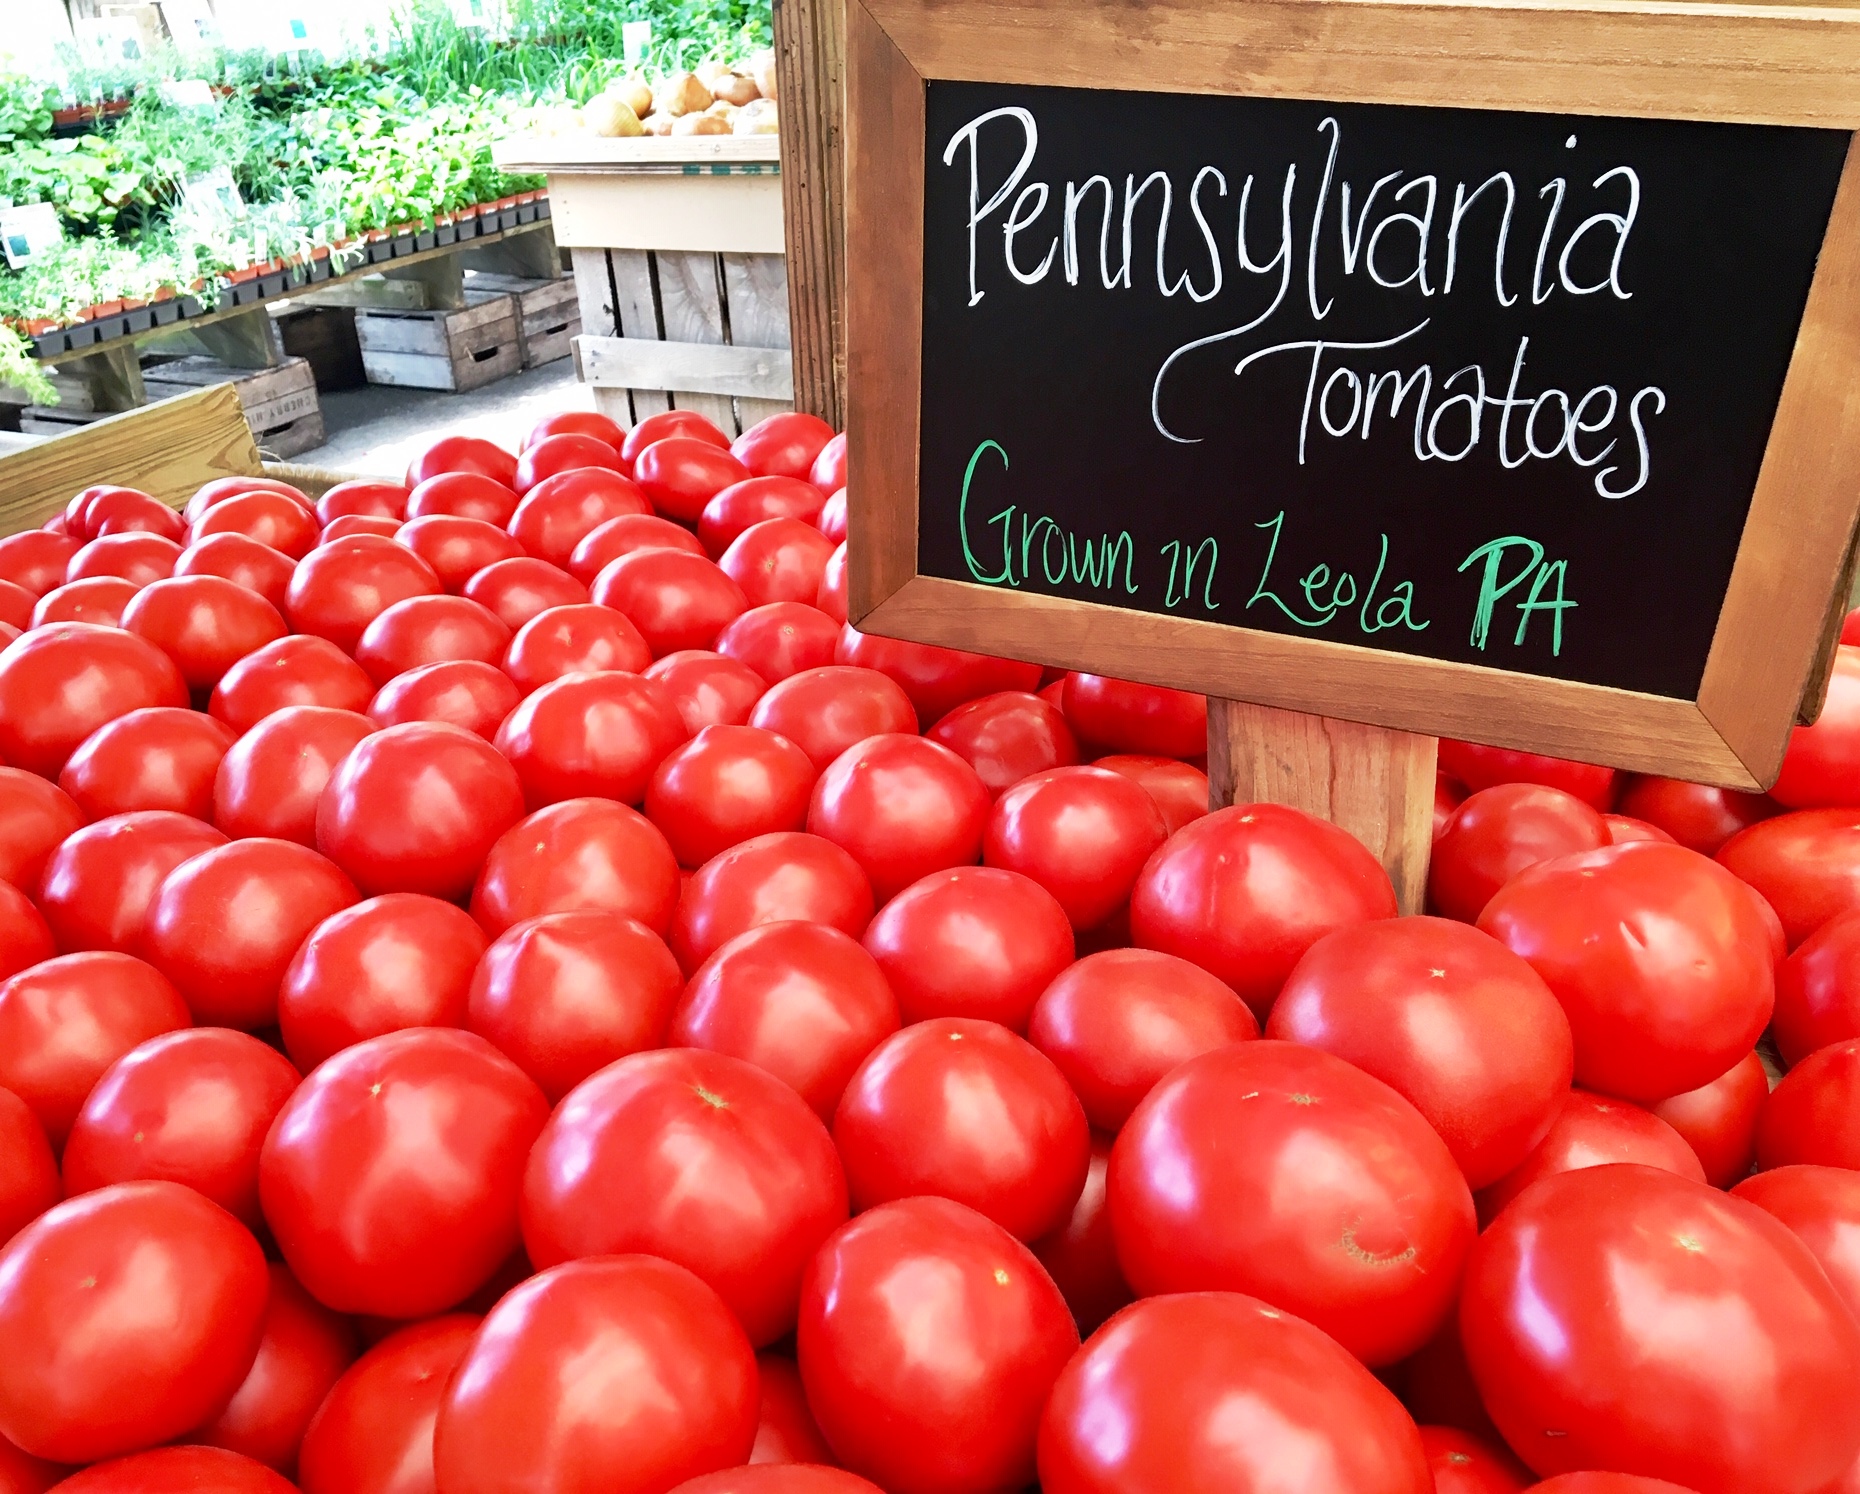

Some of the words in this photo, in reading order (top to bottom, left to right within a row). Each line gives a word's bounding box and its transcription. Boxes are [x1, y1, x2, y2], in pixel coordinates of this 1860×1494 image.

[943, 106, 1640, 444] Pennsylvania
[1234, 317, 1666, 500] Tomatoes
[959, 439, 1139, 594] Grown
[1160, 536, 1220, 610] in
[1246, 510, 1431, 633] Leola
[1457, 535, 1579, 657] PA
